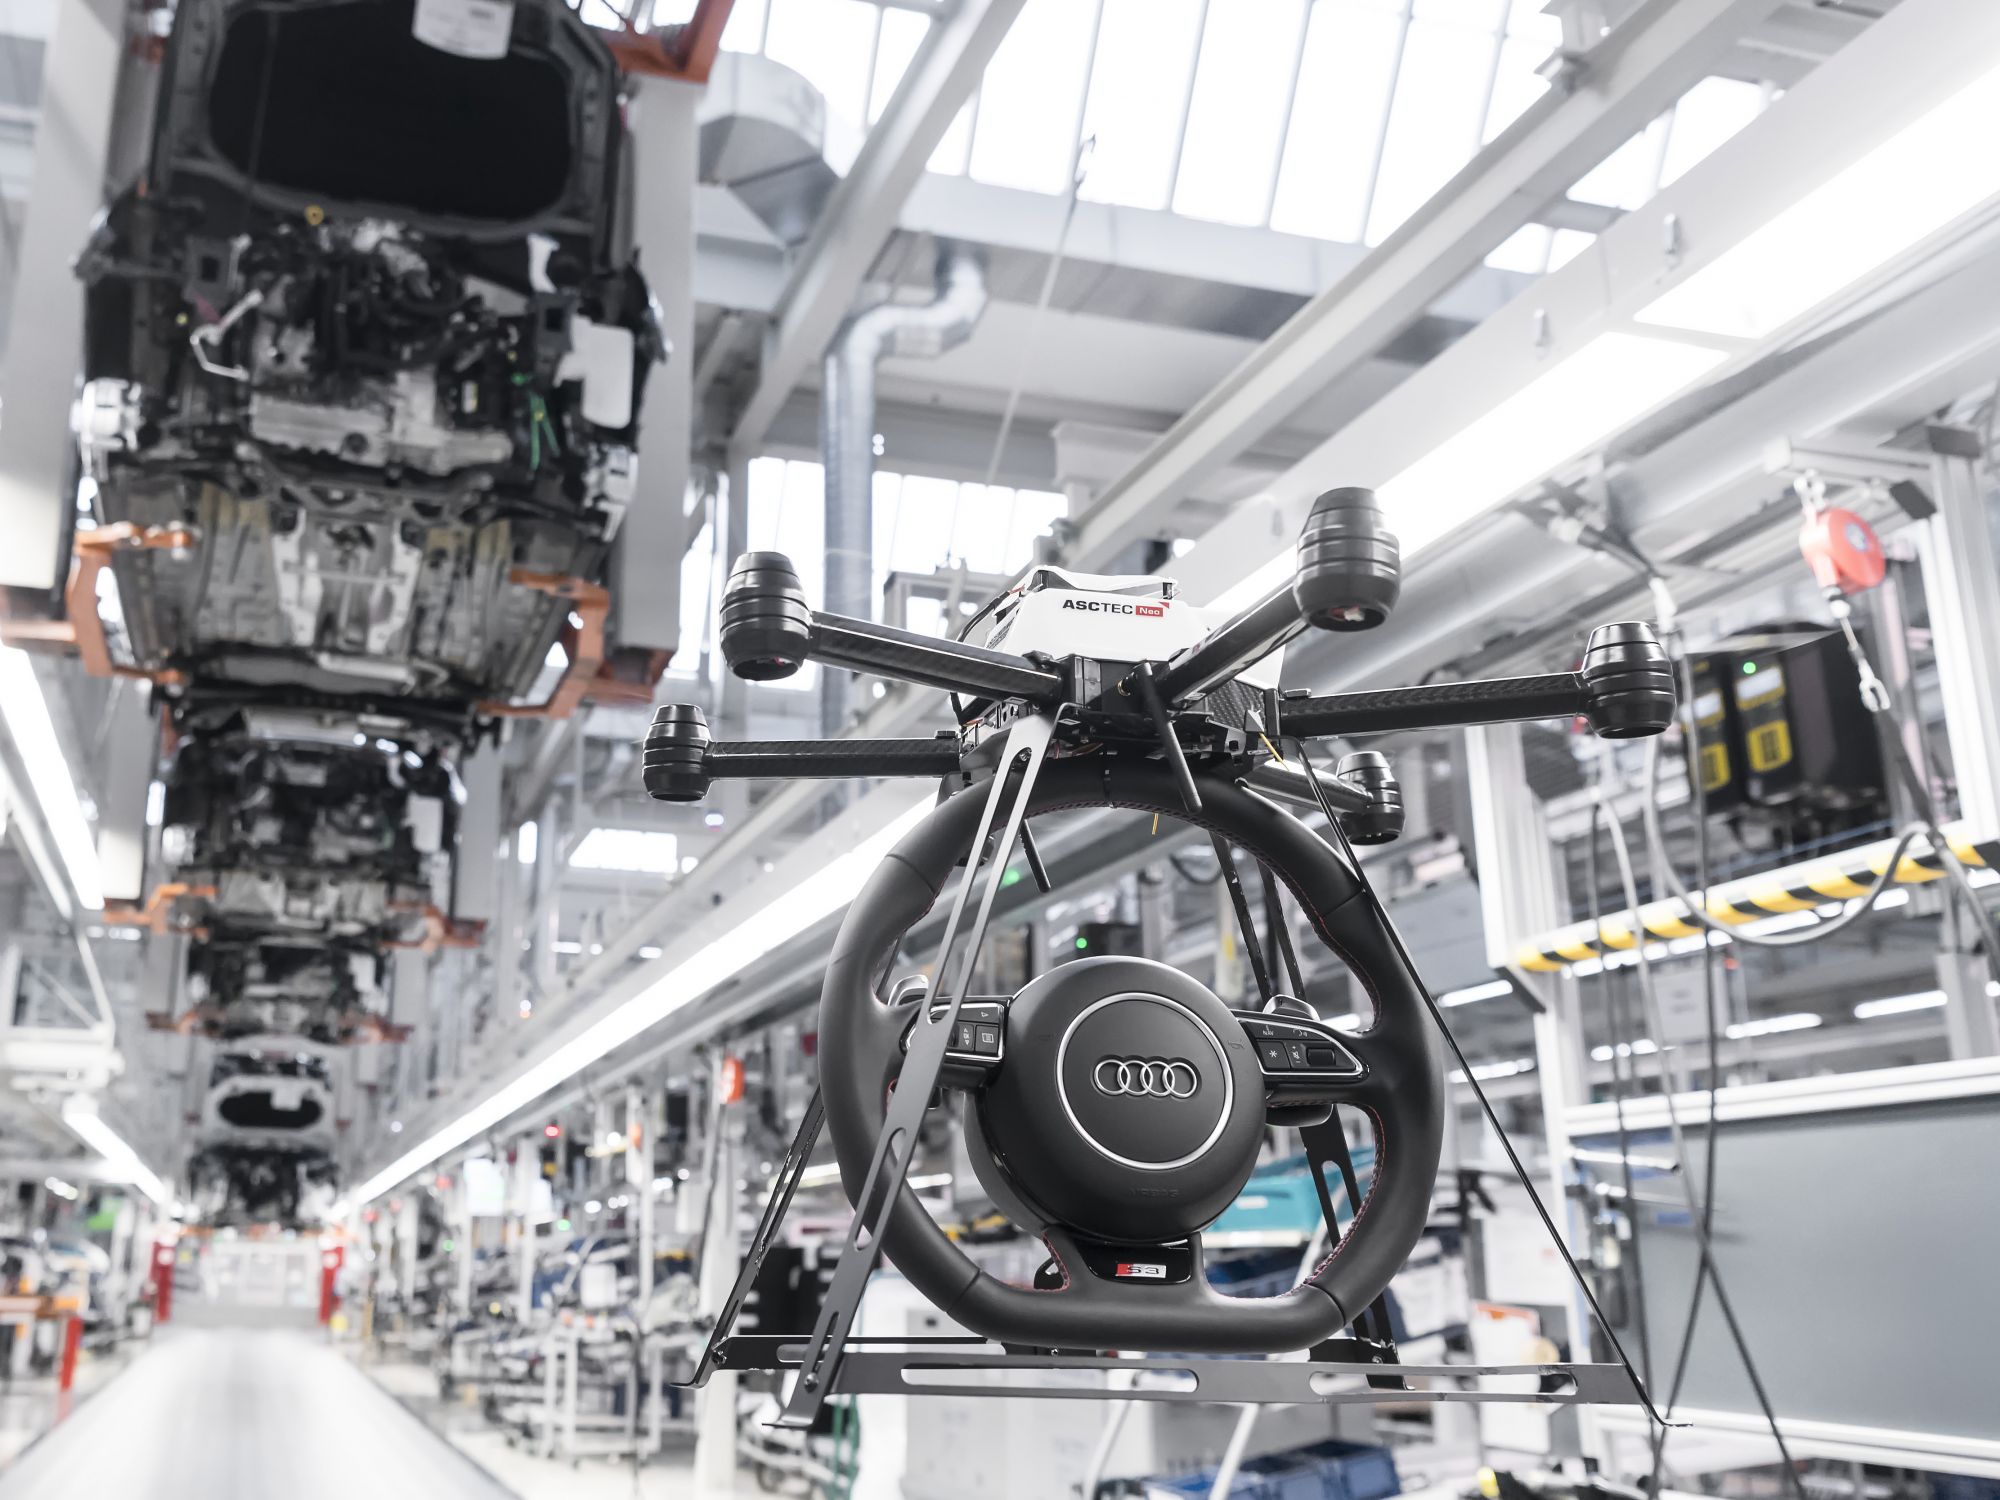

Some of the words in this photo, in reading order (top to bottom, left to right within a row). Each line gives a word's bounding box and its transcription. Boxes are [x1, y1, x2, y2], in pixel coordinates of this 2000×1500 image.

[1062, 599, 1133, 614] ASCTEC
[1139, 607, 1160, 615] Neo
[1127, 1265, 1159, 1275] S3
